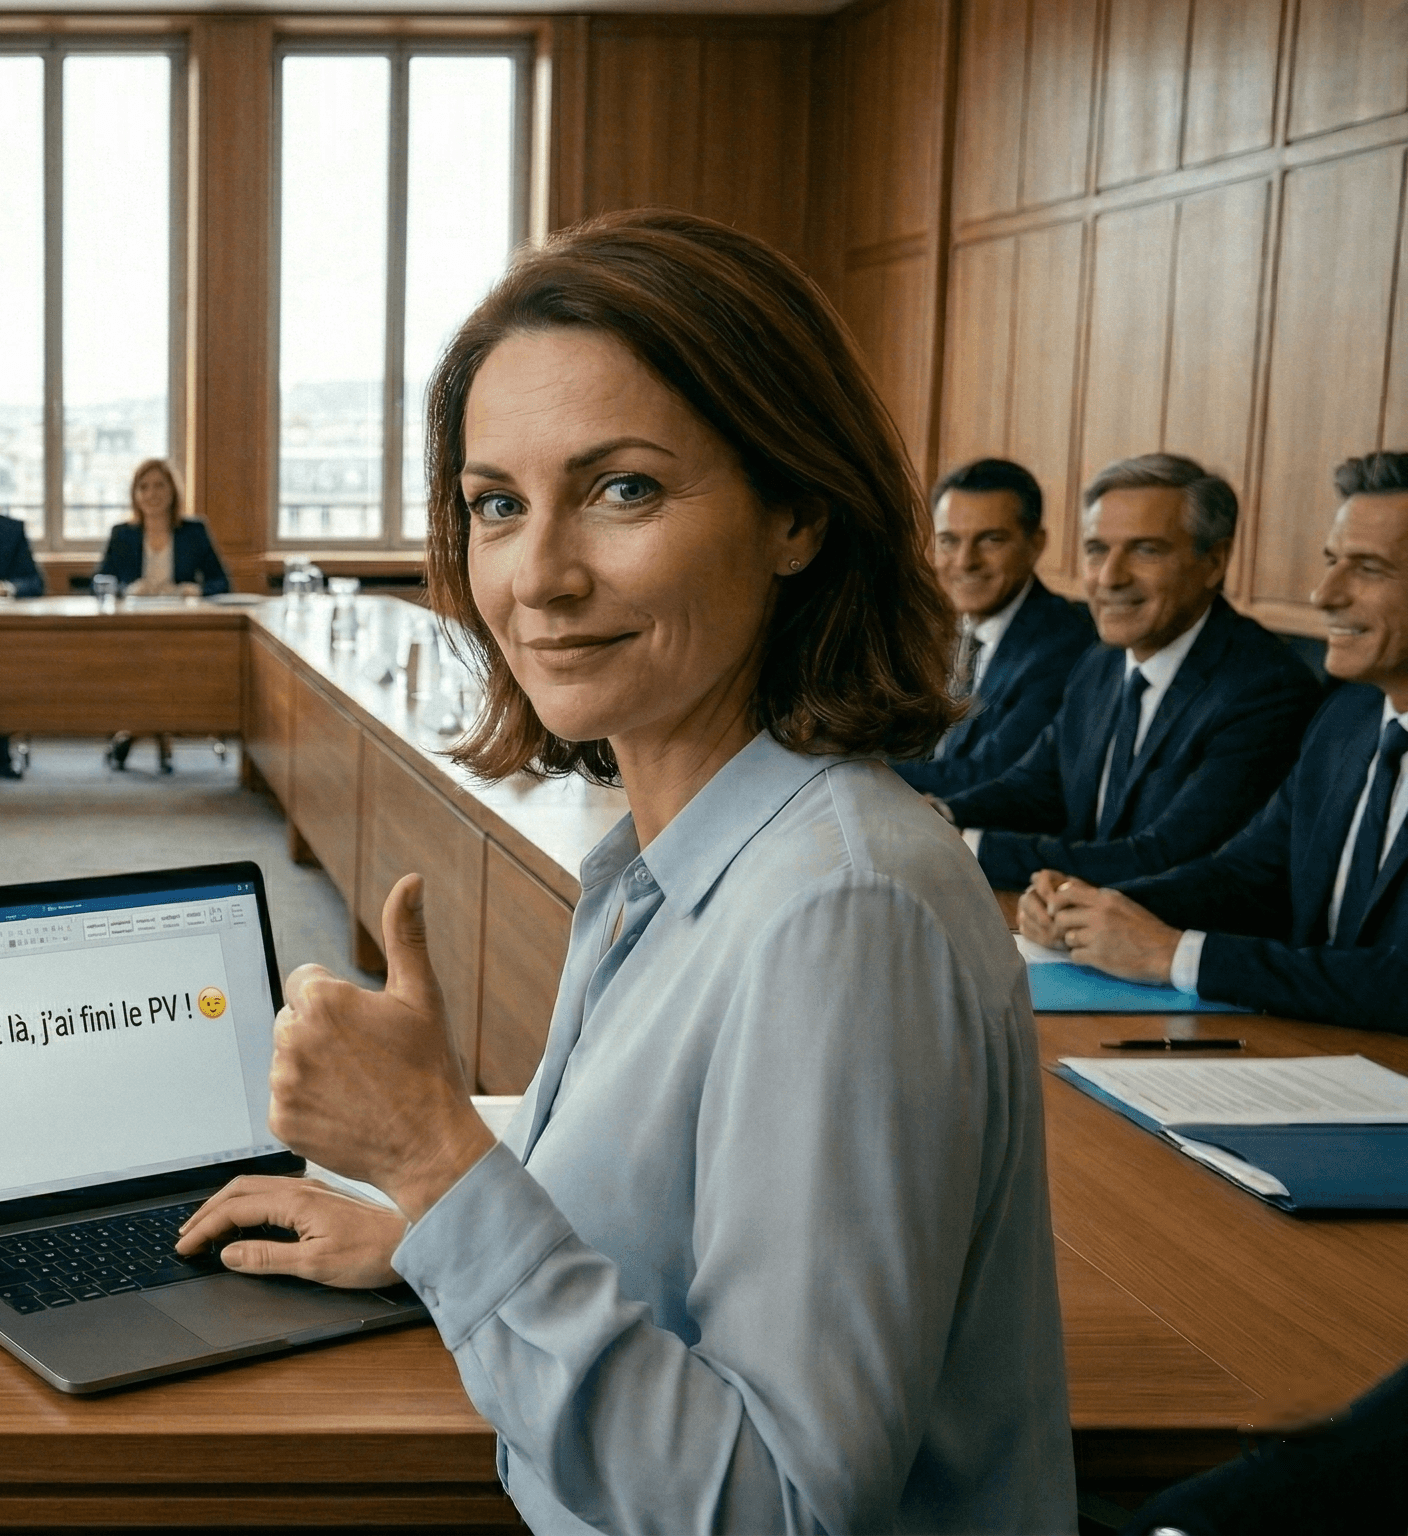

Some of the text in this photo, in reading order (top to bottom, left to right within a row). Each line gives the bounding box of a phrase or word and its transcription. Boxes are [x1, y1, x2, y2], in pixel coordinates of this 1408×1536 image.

[7, 1013, 36, 1045] là,
[40, 1010, 75, 1047] j’ai
[79, 1004, 117, 1033] fini
[121, 1000, 143, 1028] le
[148, 994, 177, 1024] PV
[184, 992, 193, 1020] !
